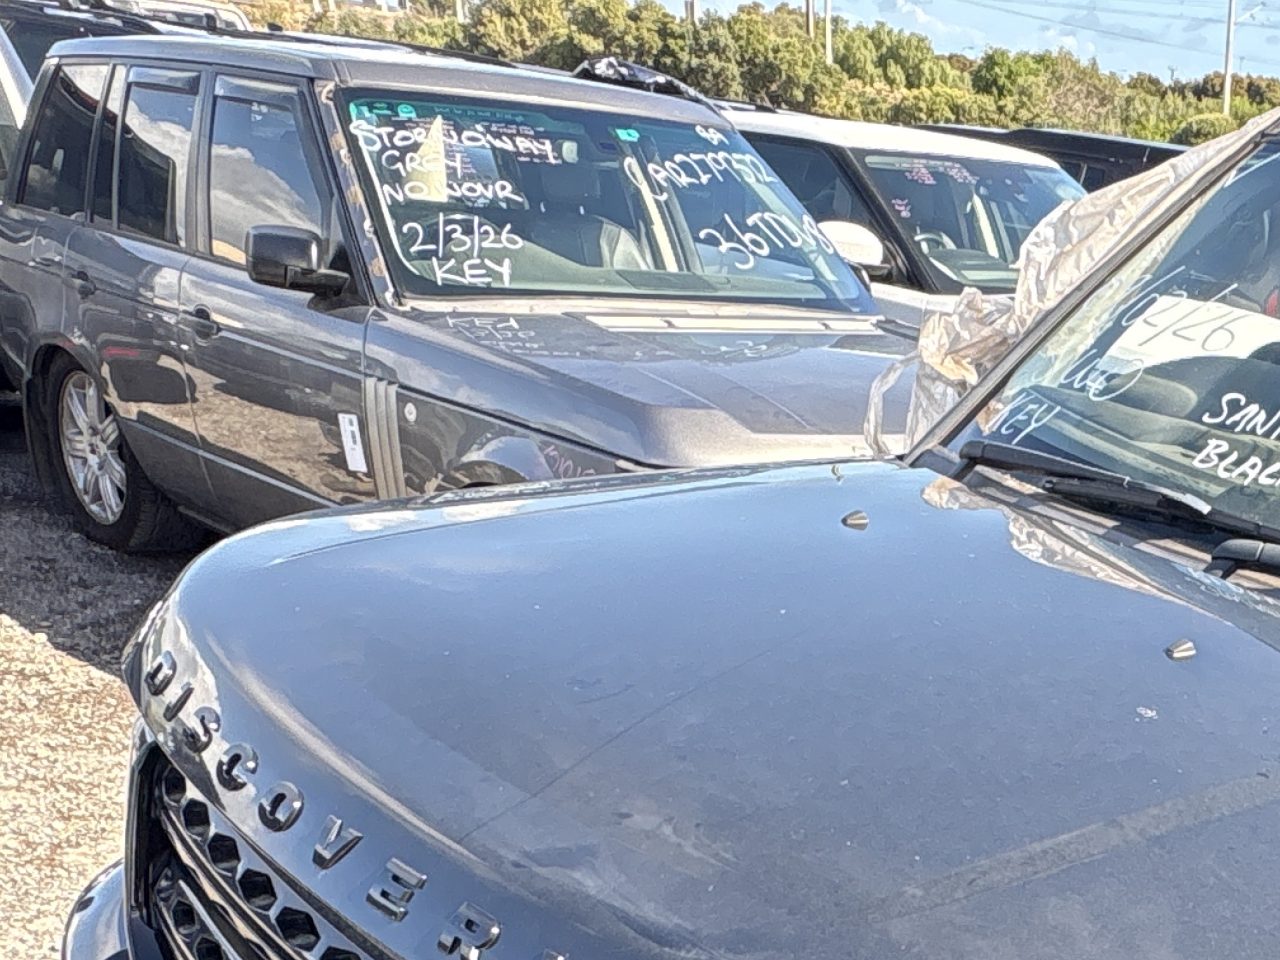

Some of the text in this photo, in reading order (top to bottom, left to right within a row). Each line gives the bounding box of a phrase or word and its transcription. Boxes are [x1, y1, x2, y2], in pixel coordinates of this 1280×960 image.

[402, 212, 523, 258] 2/3/26
[431, 256, 512, 288] KEY
[990, 390, 1062, 445] KEY
